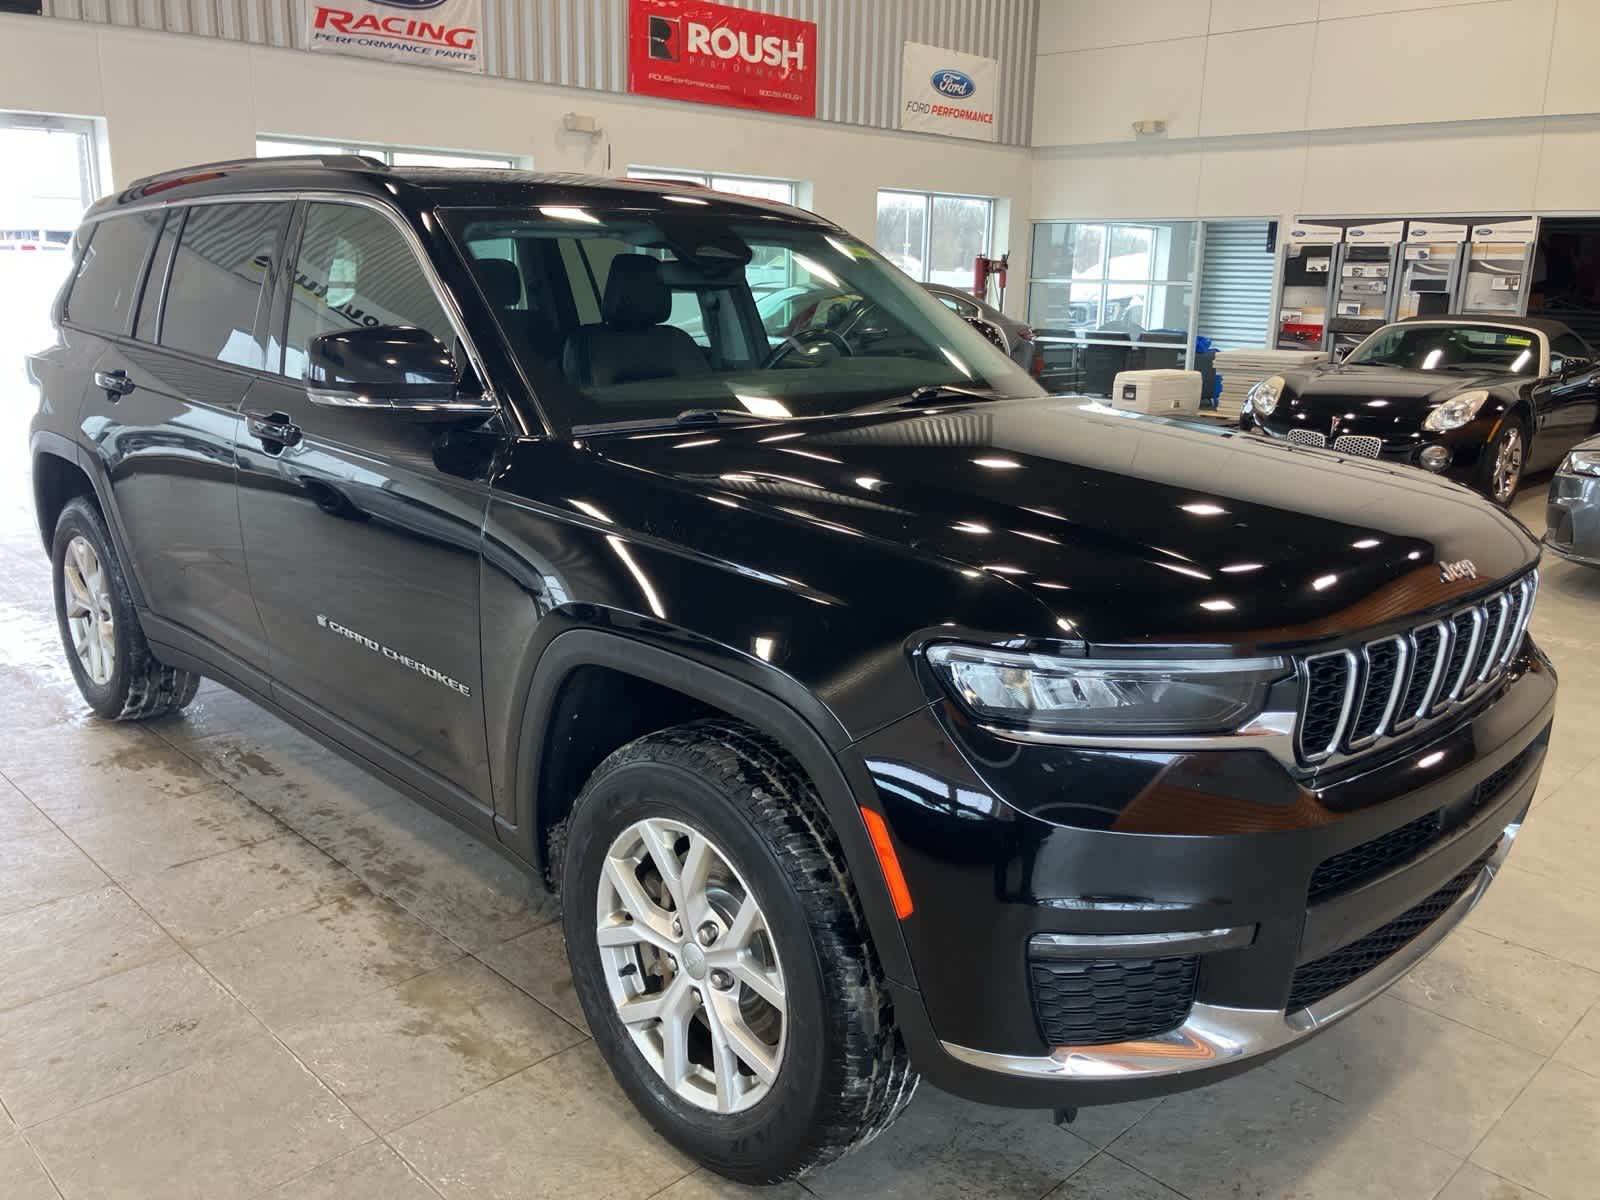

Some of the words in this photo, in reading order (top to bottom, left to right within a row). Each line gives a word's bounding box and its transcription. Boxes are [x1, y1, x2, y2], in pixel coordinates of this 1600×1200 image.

[314, 7, 476, 50] RACING
[314, 32, 432, 55] PERFORMANCE
[435, 49, 477, 62] PARTS
[687, 22, 805, 71] ROUSH
[939, 73, 968, 95] Ford
[905, 101, 931, 114] FORD
[931, 105, 993, 124] PERFORMANCE
[1439, 559, 1476, 583] Jeep
[328, 621, 380, 651] GRAND
[382, 646, 473, 697] CHEROKEE
